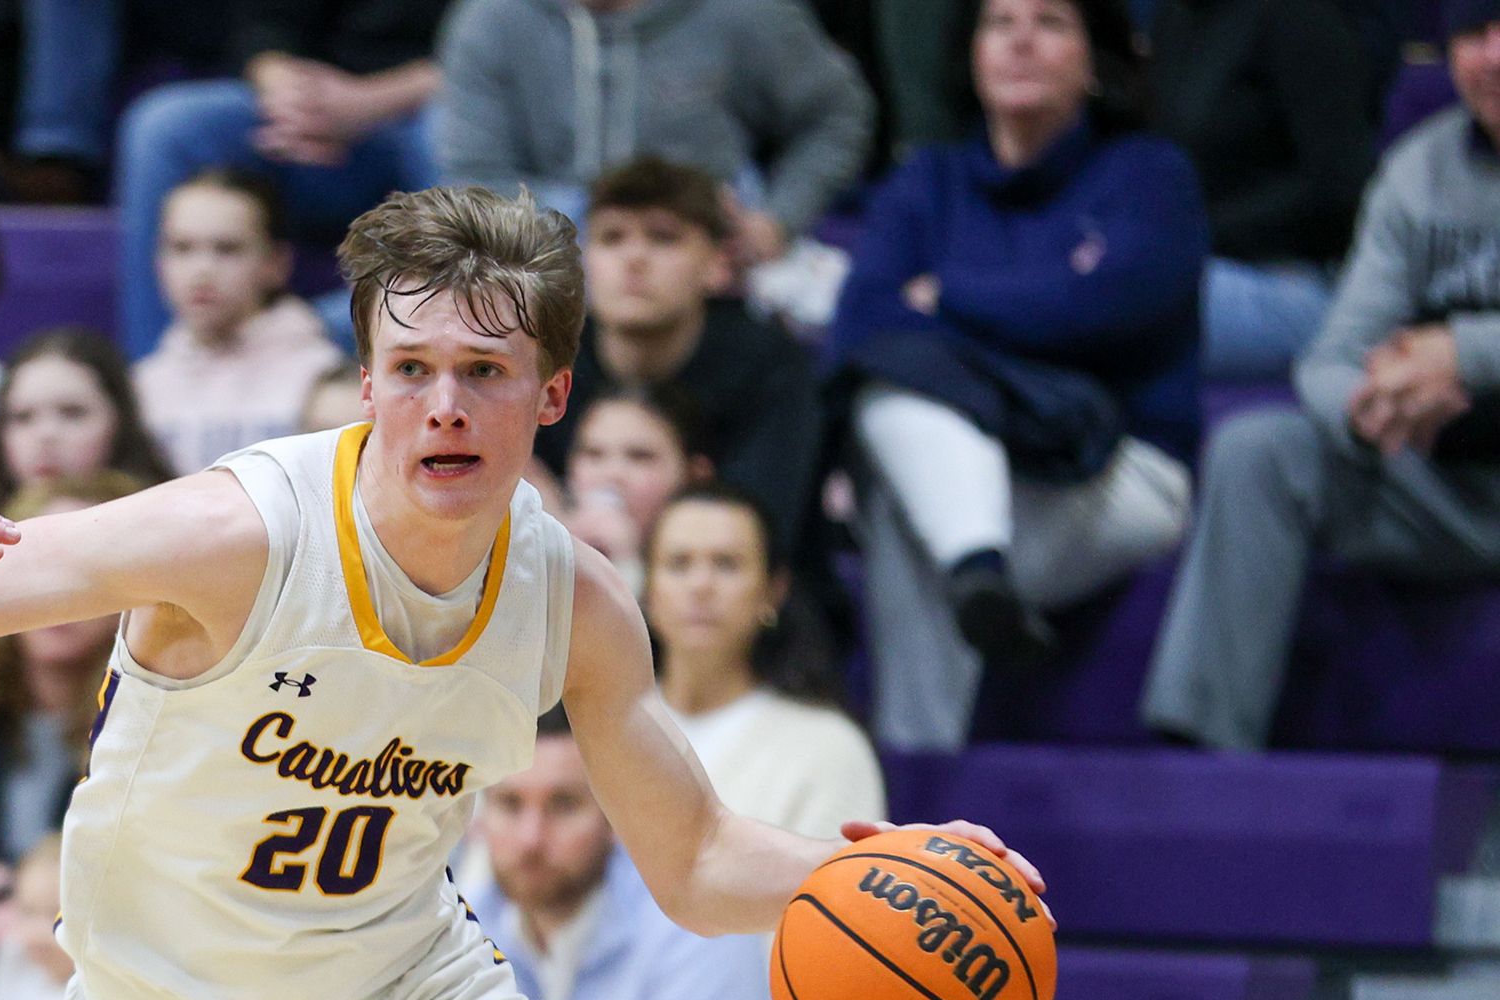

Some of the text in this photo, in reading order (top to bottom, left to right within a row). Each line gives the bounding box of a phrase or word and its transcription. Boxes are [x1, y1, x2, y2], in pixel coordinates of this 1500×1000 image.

[240, 711, 474, 800] Cavaliers
[237, 805, 398, 896] 20
[924, 836, 1039, 923] NCAA
